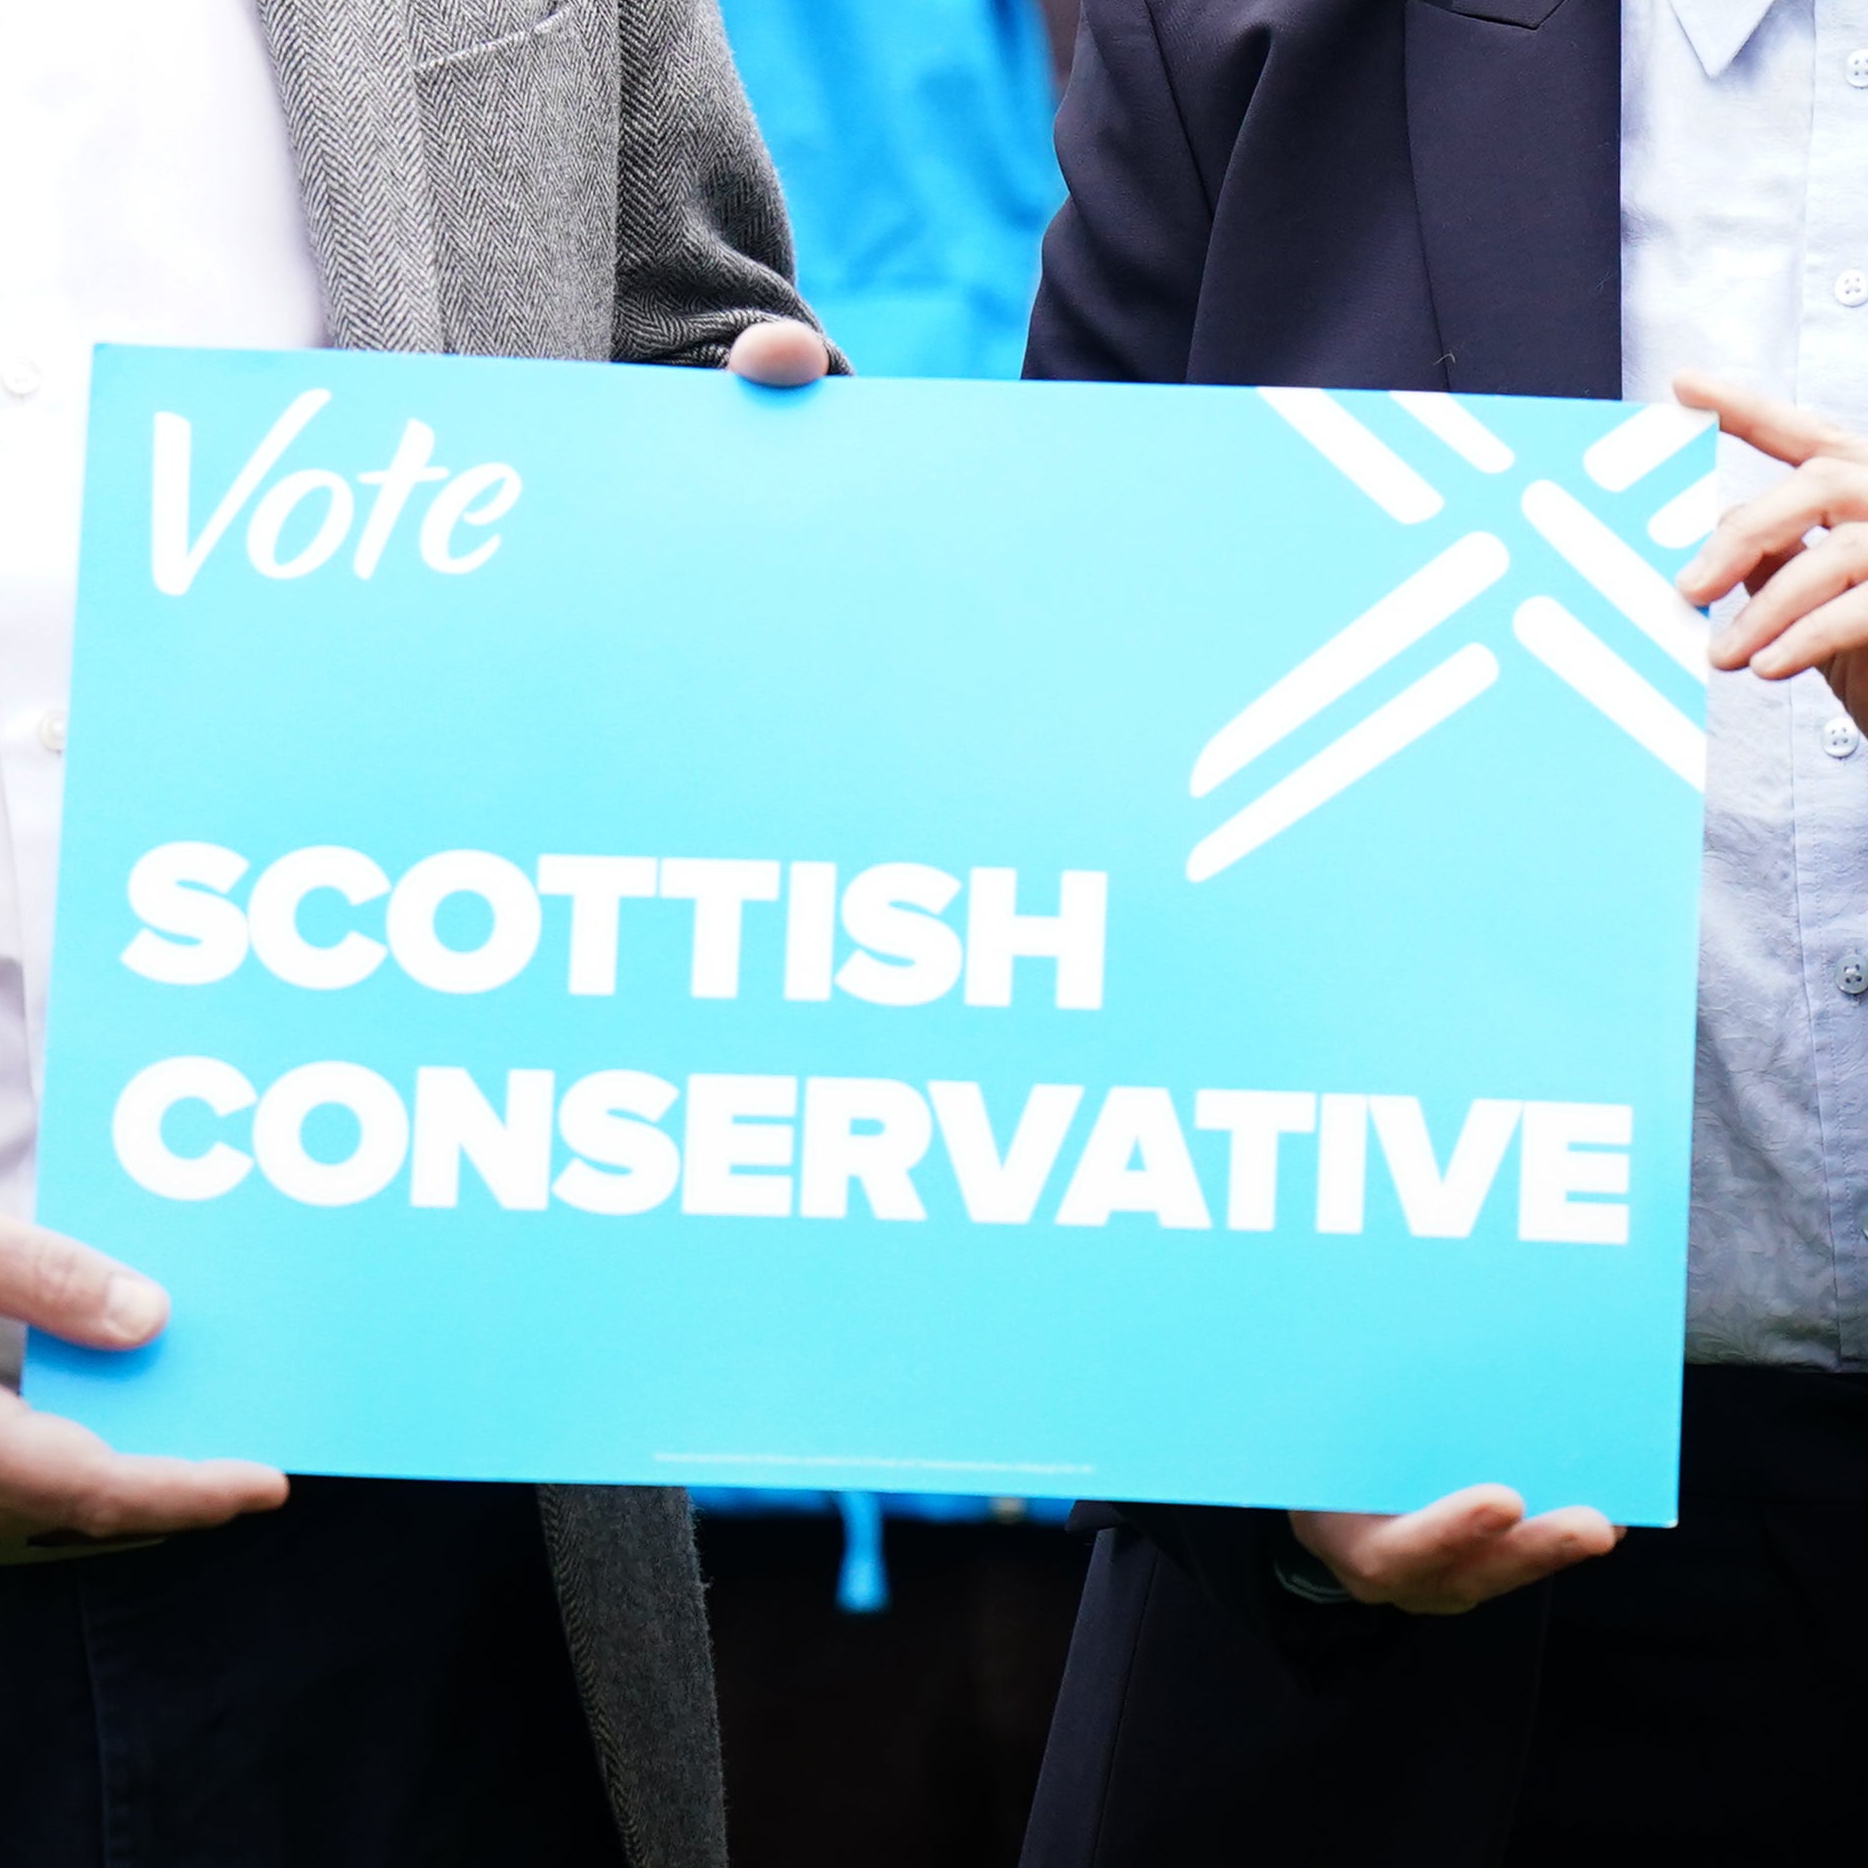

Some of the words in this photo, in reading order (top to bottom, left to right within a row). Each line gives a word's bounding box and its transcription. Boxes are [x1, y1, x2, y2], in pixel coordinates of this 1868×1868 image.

[150, 386, 524, 598] Vote
[118, 839, 1110, 1012] SCOTTISH
[110, 1054, 1636, 1247] CONSERVATIVE
